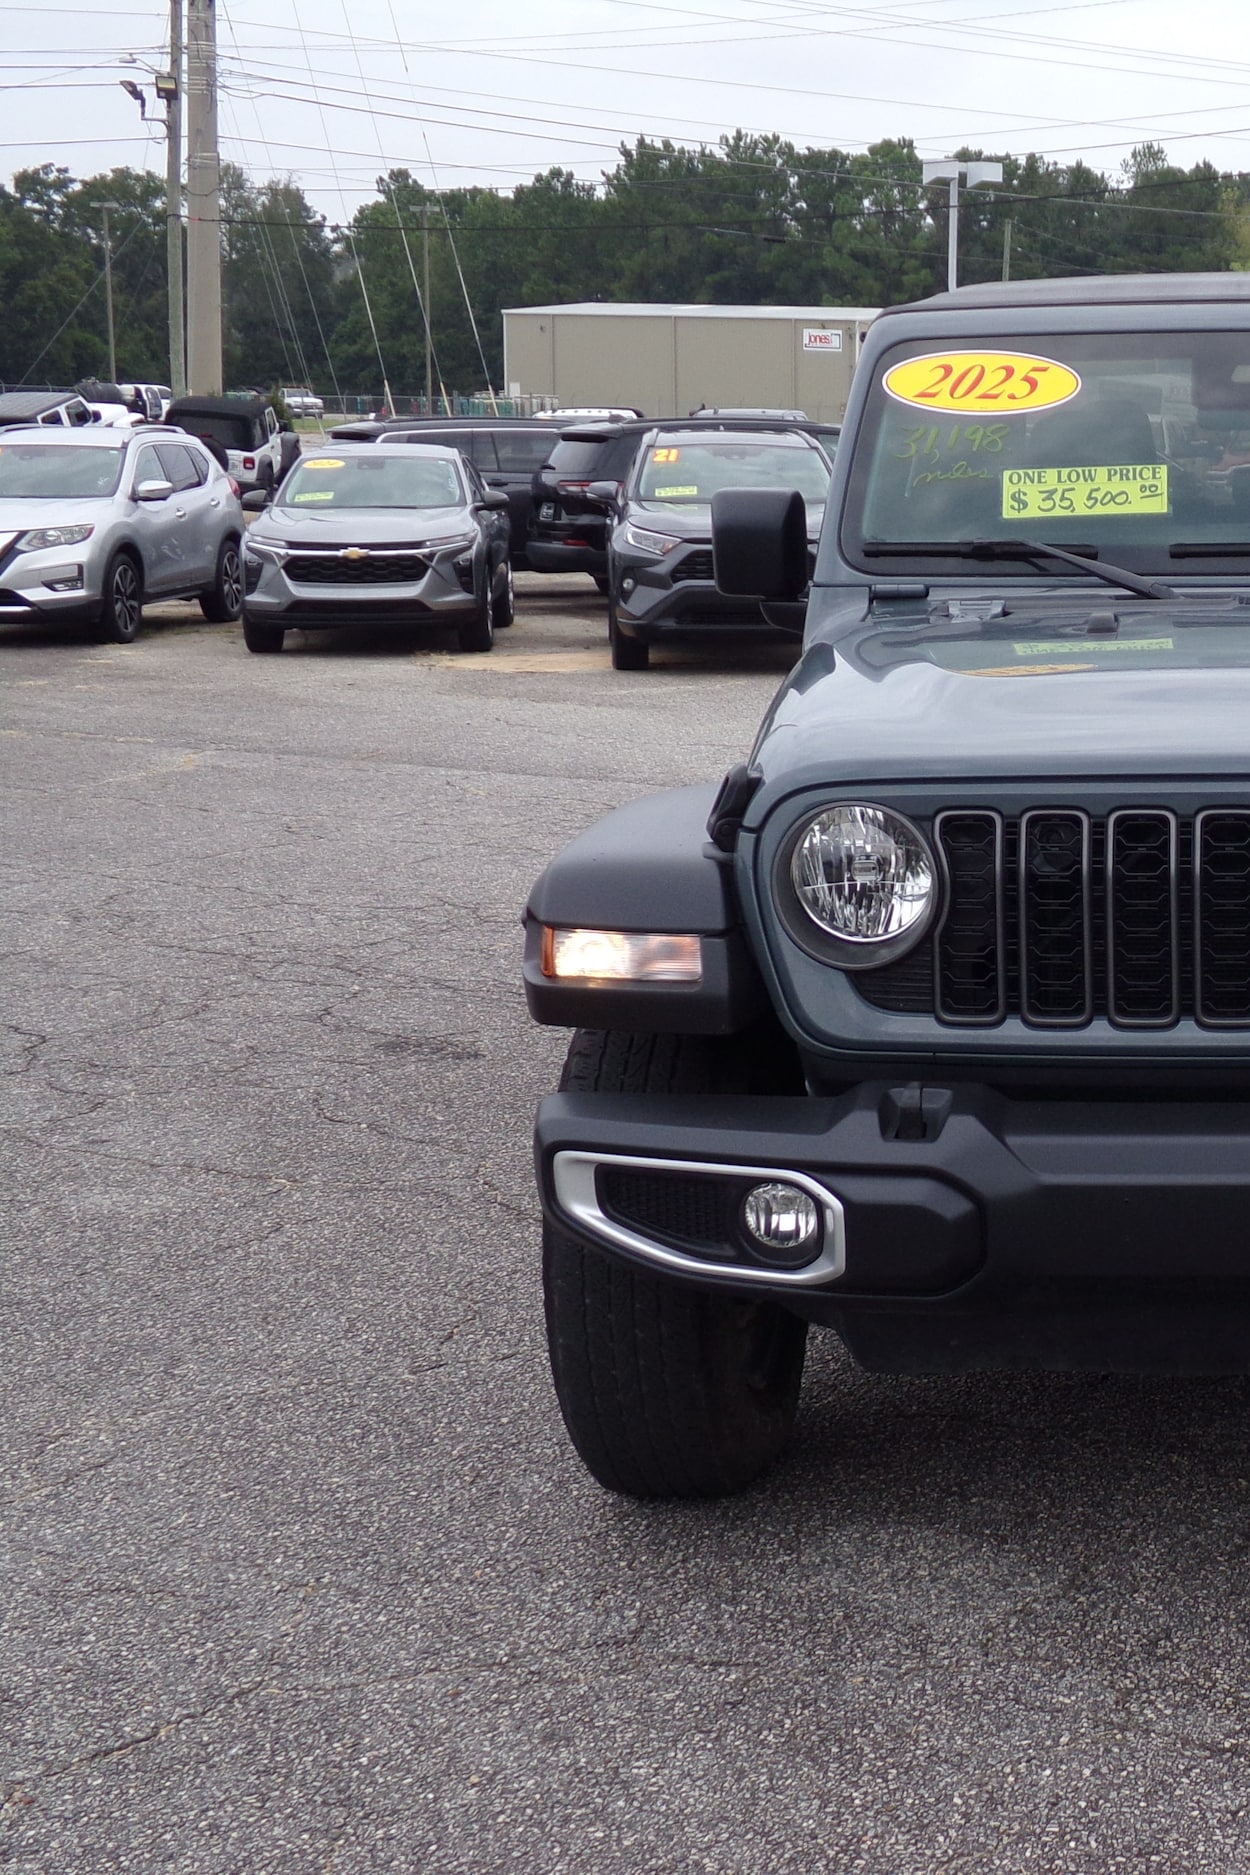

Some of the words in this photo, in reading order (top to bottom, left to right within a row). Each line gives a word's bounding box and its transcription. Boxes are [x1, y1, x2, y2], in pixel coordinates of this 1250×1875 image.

[913, 364, 1050, 400] 2025
[653, 448, 679, 462] 21
[1008, 471, 1048, 485] ONE
[1056, 469, 1098, 483] LOW
[1107, 466, 1162, 482] PRICE
